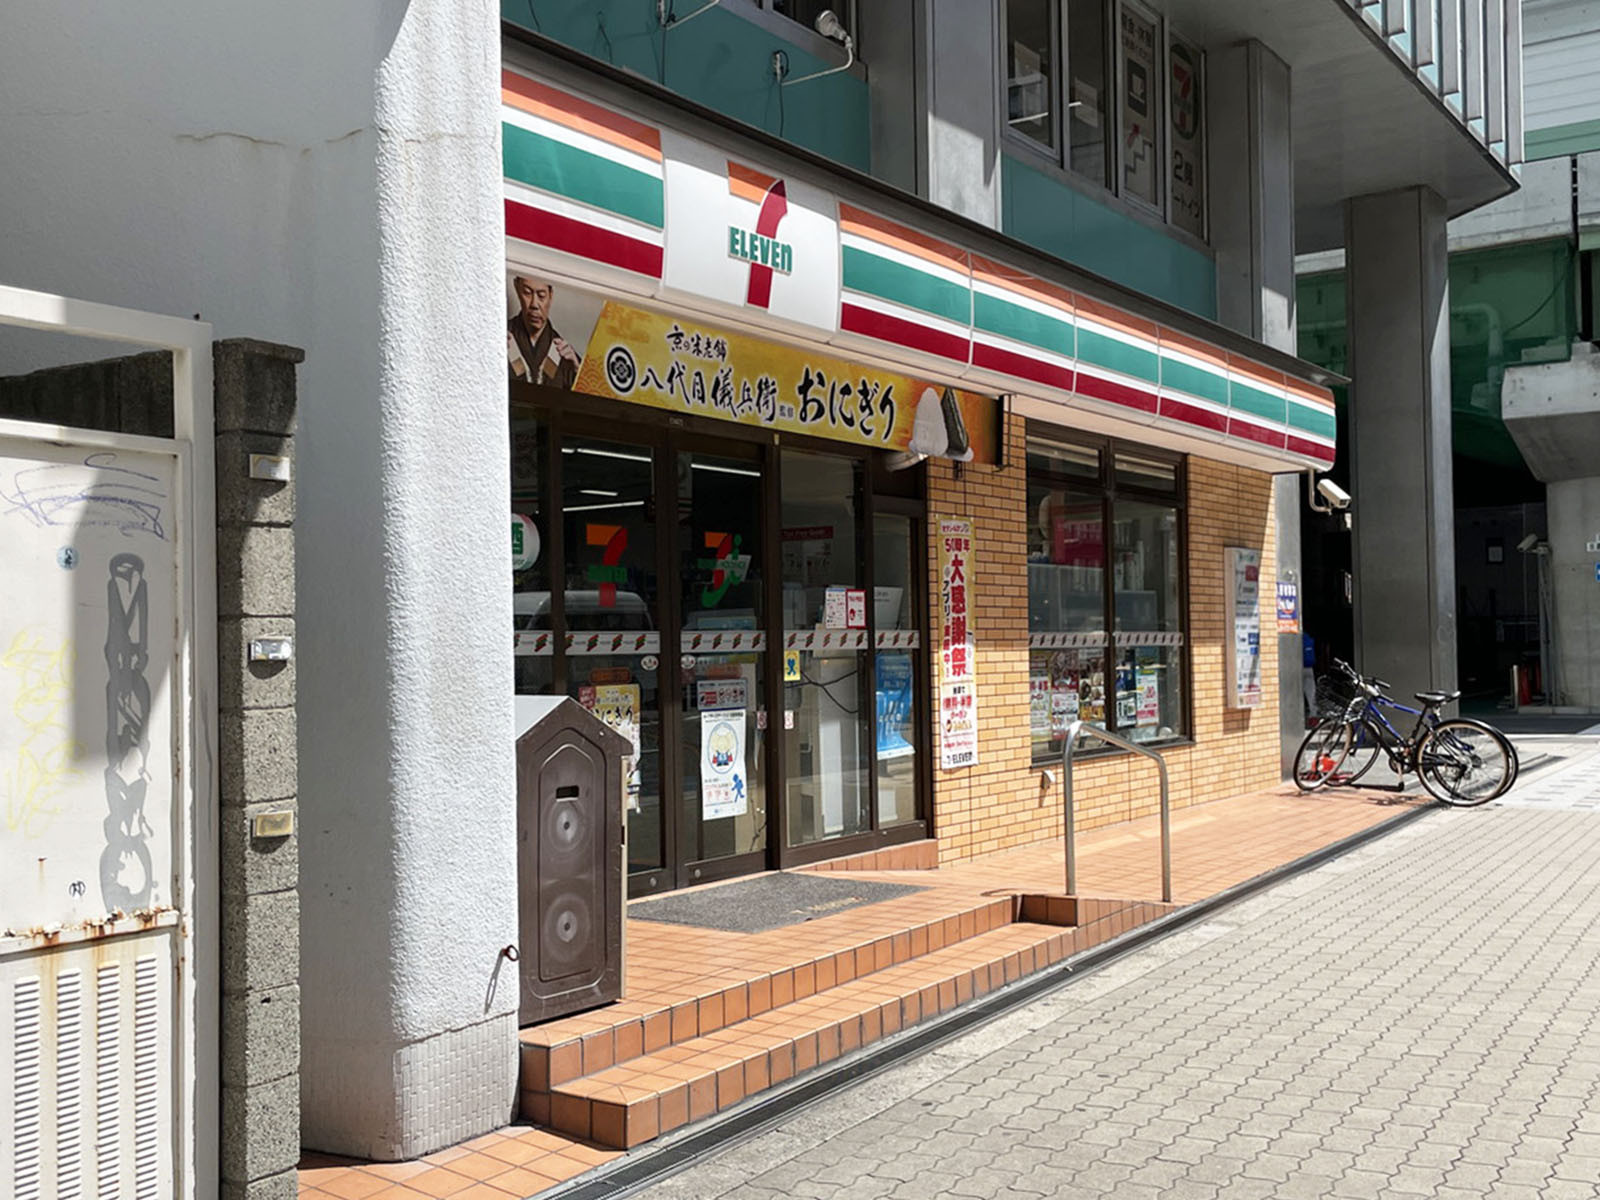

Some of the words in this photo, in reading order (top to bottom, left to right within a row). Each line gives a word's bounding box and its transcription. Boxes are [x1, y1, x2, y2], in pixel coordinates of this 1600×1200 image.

[727, 160, 788, 309] 7
[640, 361, 778, 422] 八代目儀兵衛
[797, 366, 894, 441] おにぎり
[950, 553, 967, 677] 大感謝祭
[590, 705, 633, 726] にぎり
